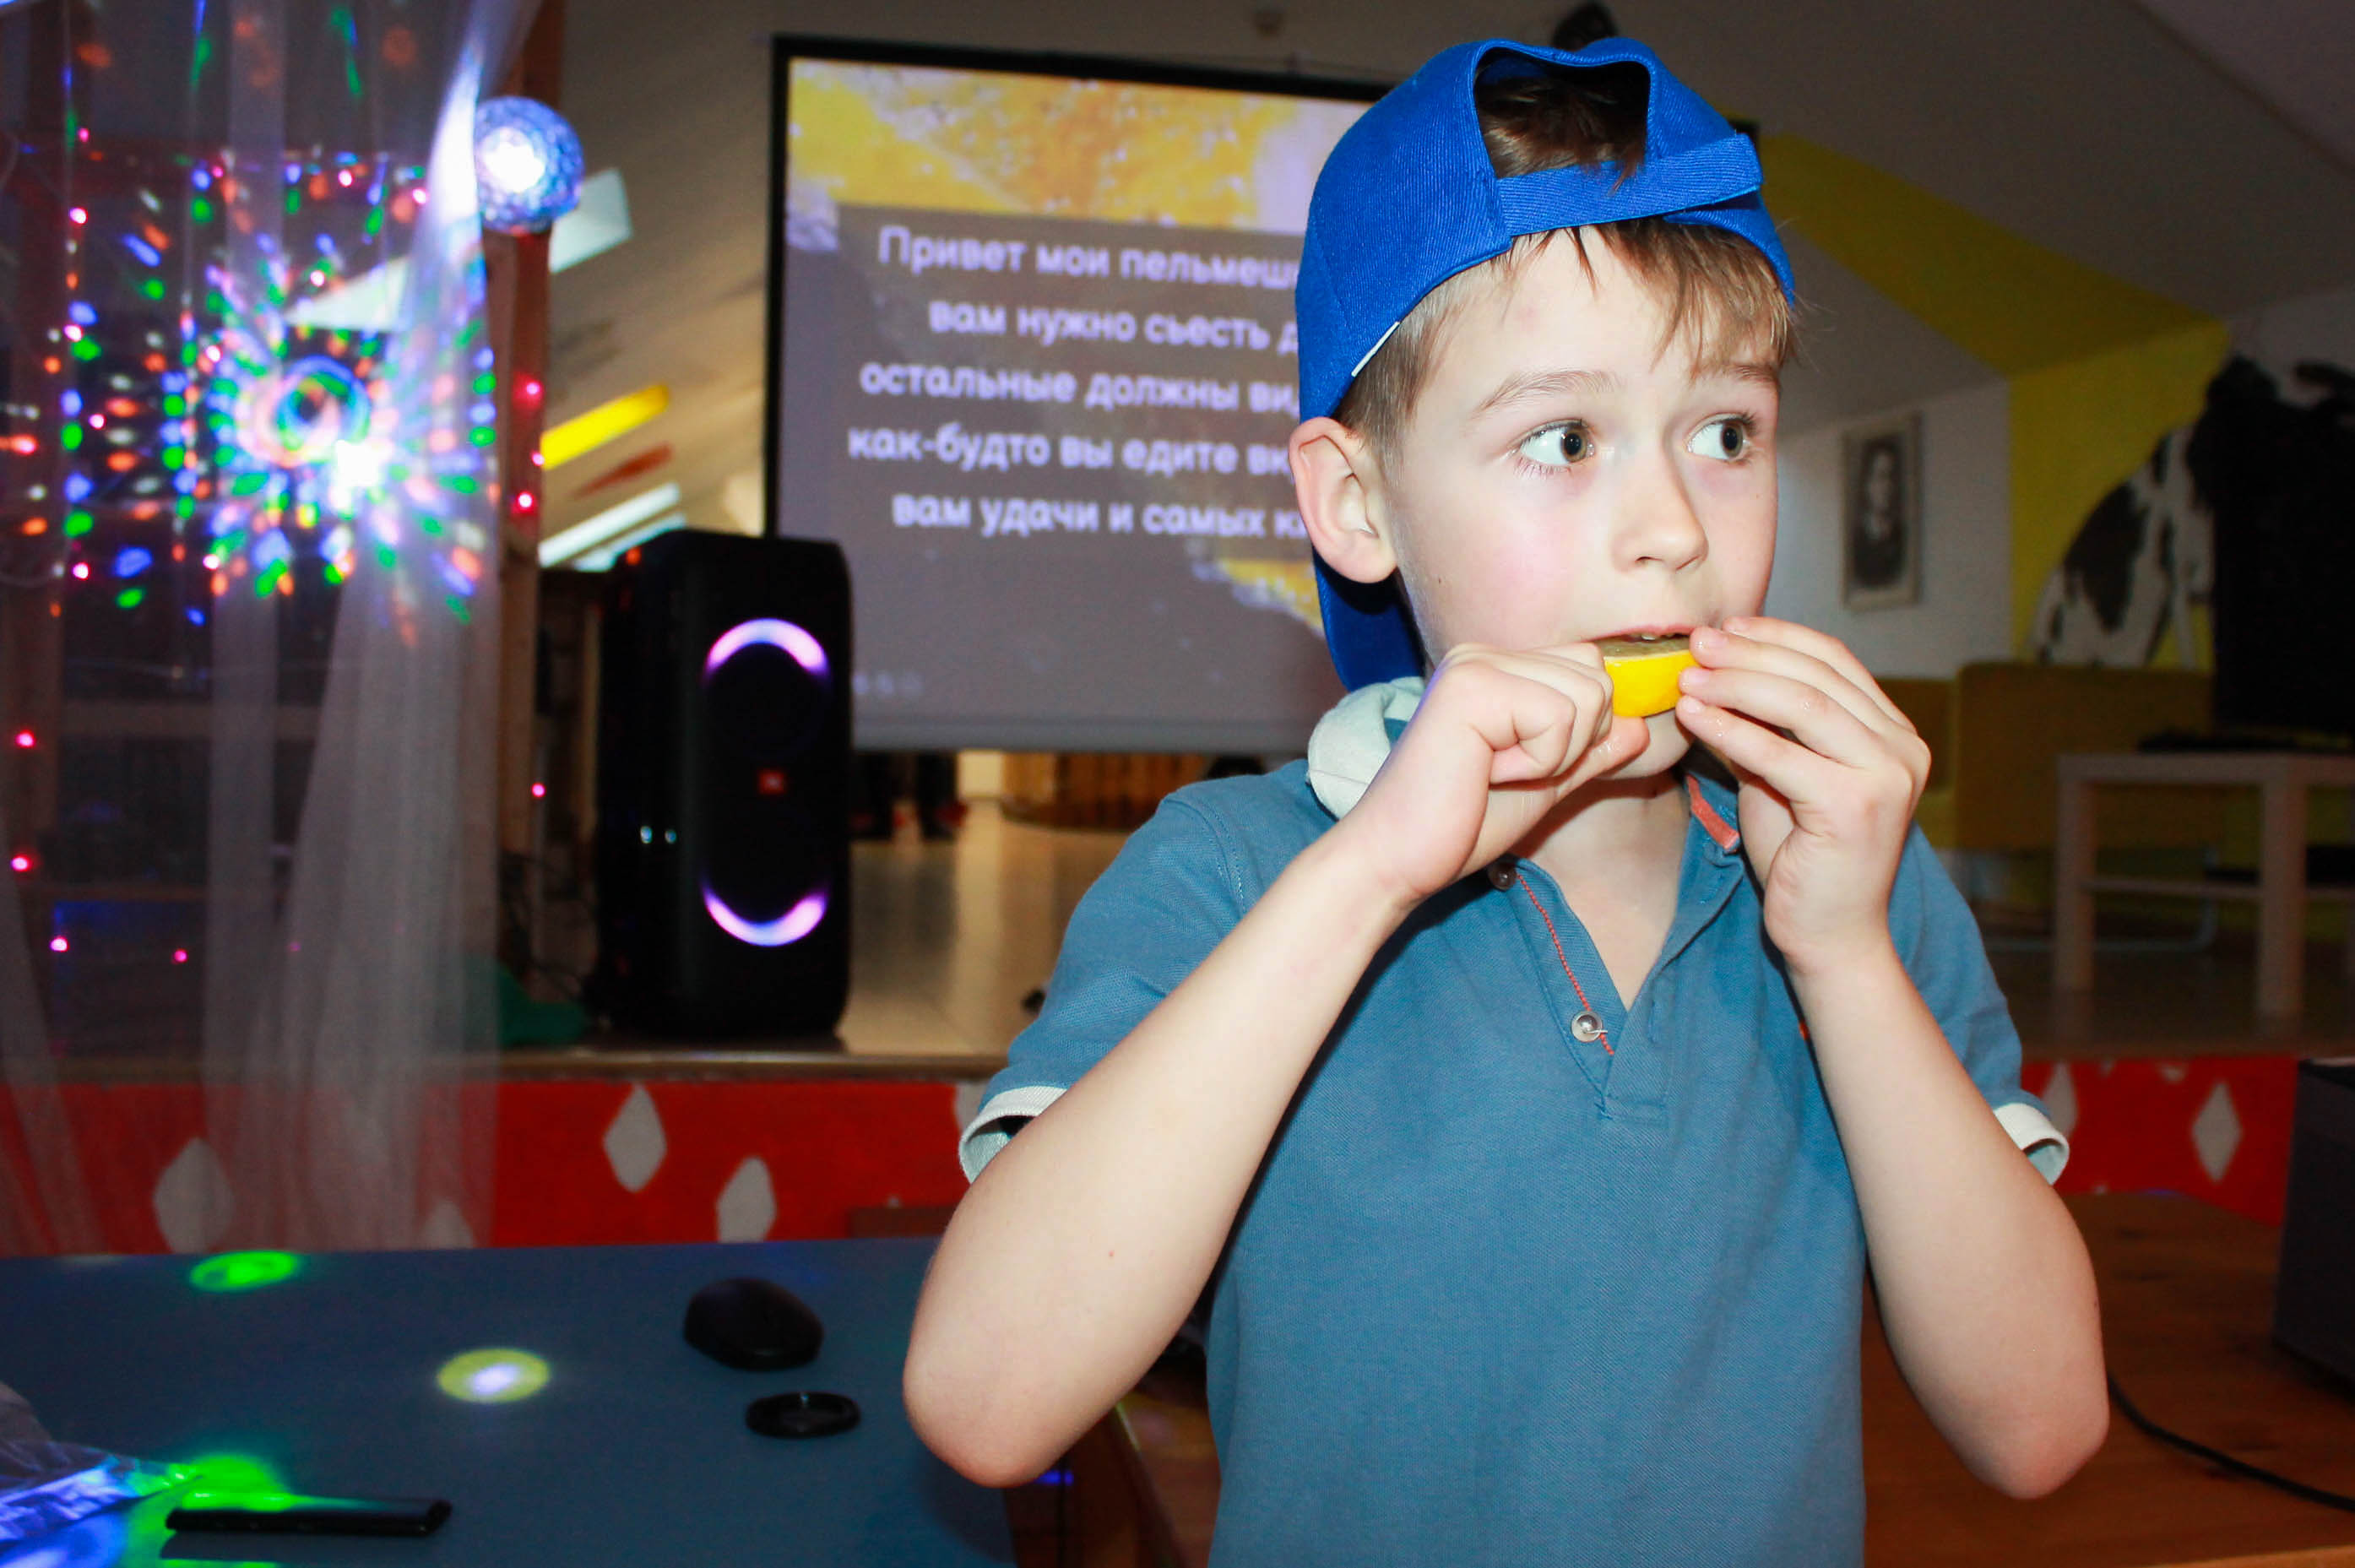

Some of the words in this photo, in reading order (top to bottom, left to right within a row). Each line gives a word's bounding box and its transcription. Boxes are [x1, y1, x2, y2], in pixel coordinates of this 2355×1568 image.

[880, 225, 1026, 274] Привет
[1037, 245, 1110, 277] мои
[1121, 248, 1299, 289] пельмеш
[930, 301, 1006, 334] вам
[1017, 307, 1136, 346] нужно
[860, 362, 1077, 403] остальные
[1084, 373, 1239, 411] должны
[1249, 382, 1299, 418] ви
[849, 423, 1050, 471] как-будто
[1061, 436, 1113, 468] вы
[1122, 439, 1238, 478] едите
[1247, 444, 1295, 484] вк
[893, 495, 970, 527] вам
[979, 498, 1099, 538] удачи
[1109, 504, 1134, 534] и
[1143, 505, 1264, 538] самых
